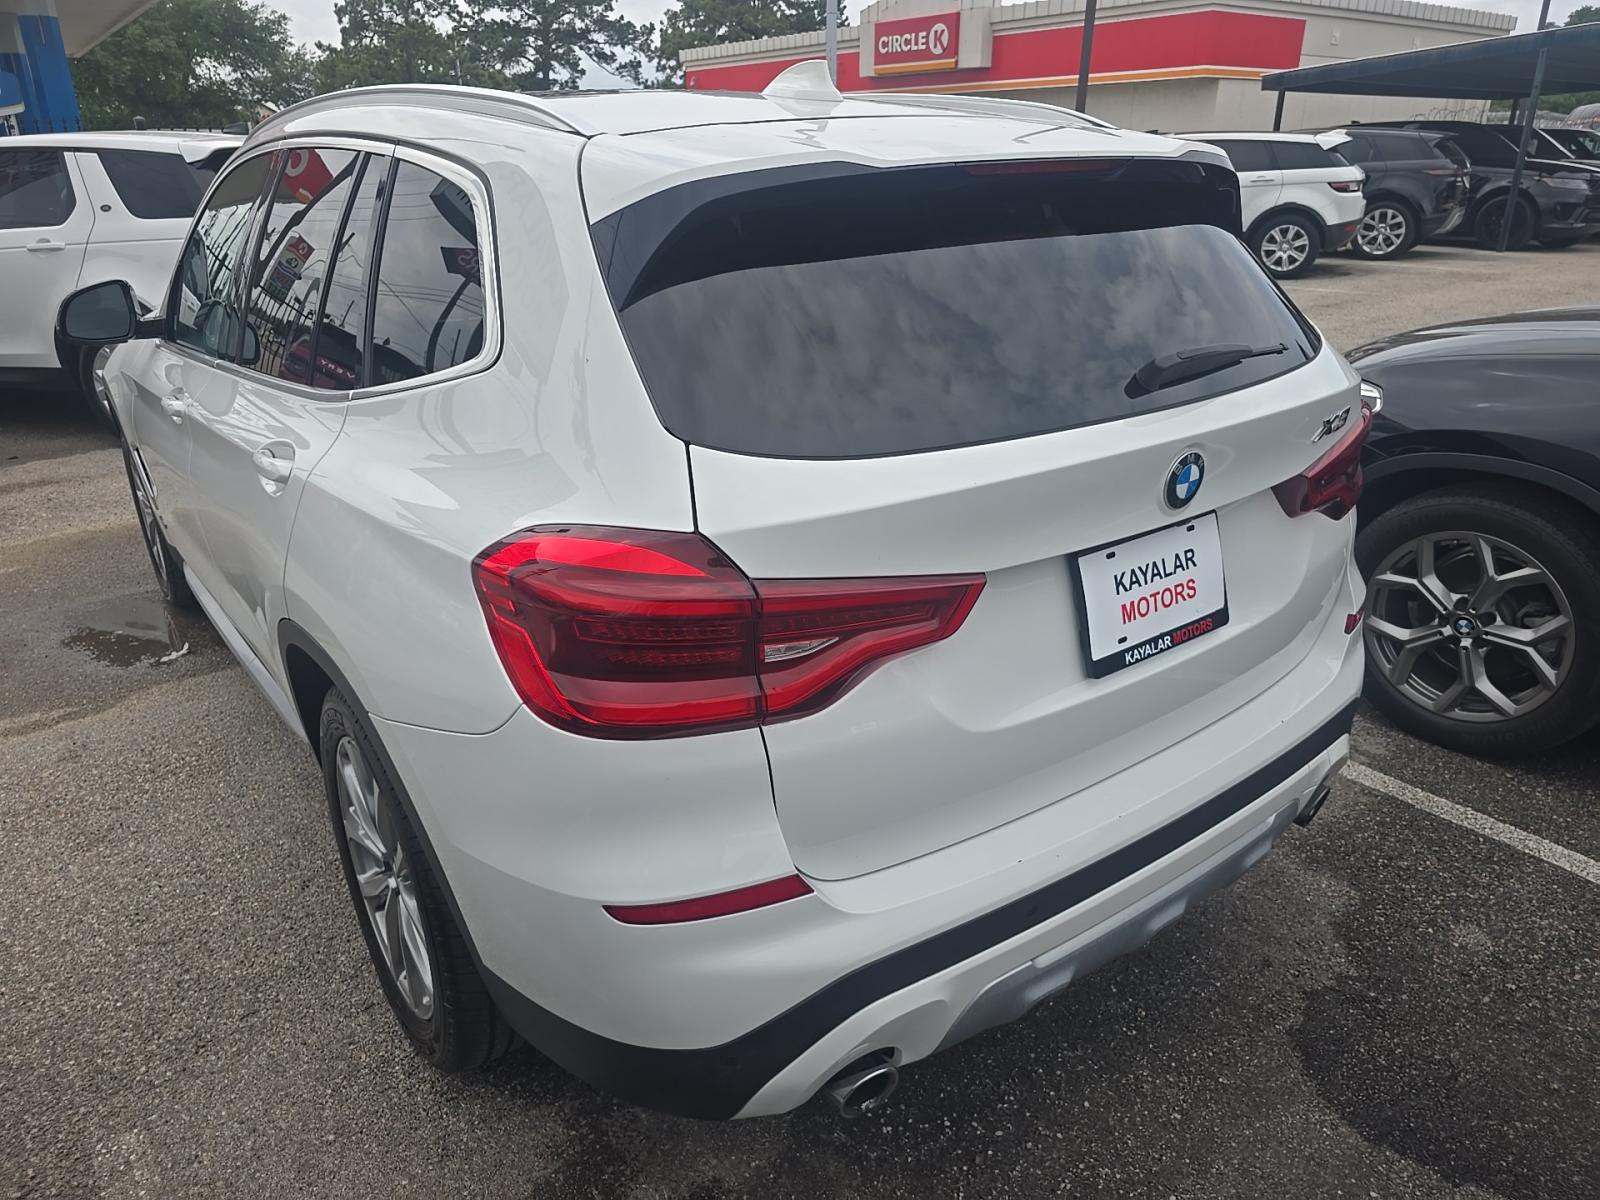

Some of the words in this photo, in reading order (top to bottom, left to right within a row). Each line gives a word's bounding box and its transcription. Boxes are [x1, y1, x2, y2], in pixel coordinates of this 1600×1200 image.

[878, 31, 927, 54] CIRCLE
[932, 27, 948, 50] K
[1113, 547, 1198, 596] KAYALAR
[1120, 577, 1198, 625] MOTORS
[1124, 635, 1172, 665] KAYALAR
[1172, 618, 1213, 645] MOTORS
